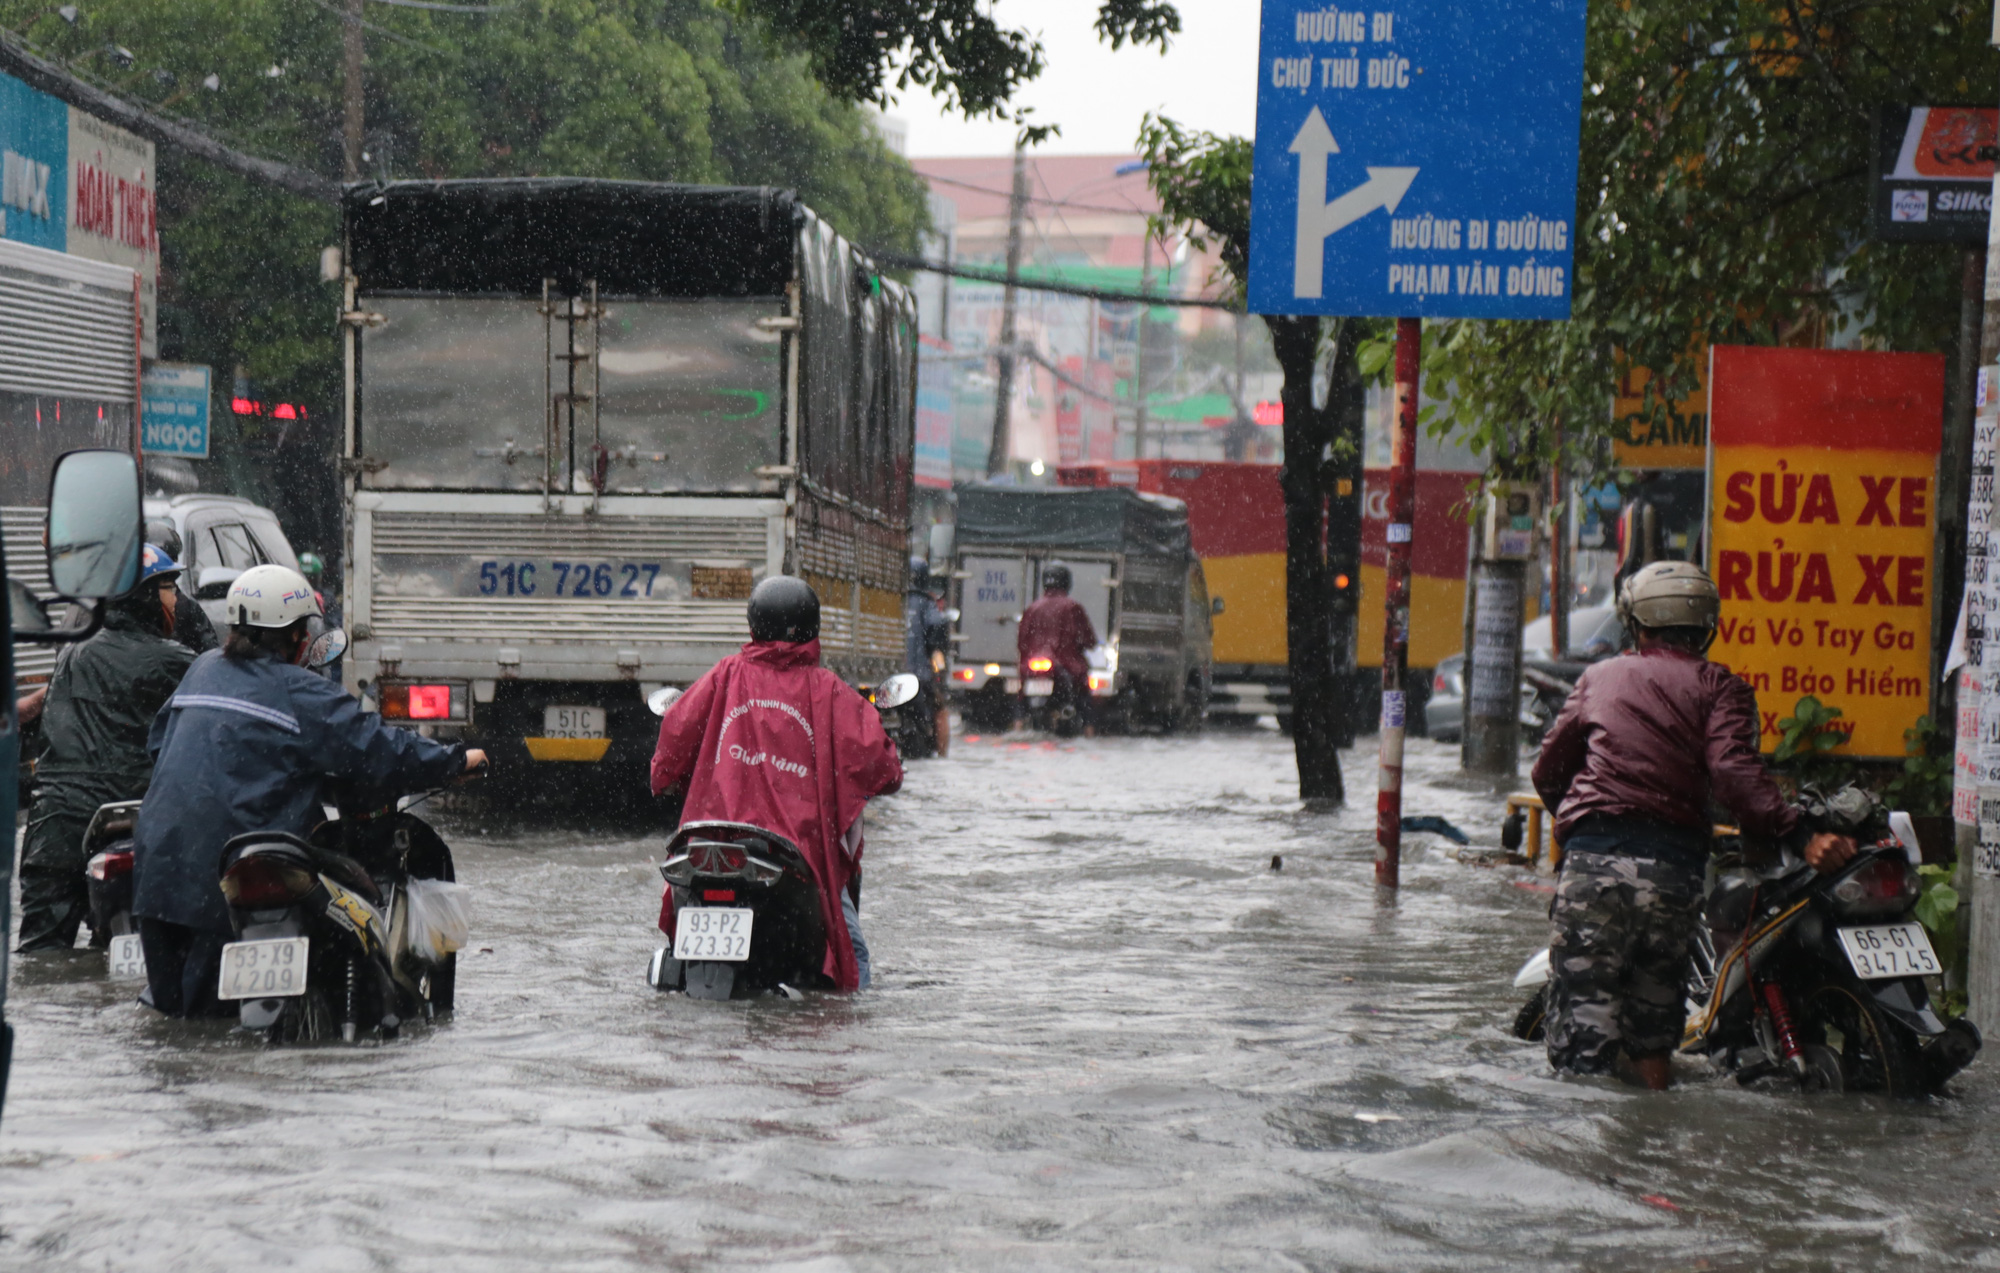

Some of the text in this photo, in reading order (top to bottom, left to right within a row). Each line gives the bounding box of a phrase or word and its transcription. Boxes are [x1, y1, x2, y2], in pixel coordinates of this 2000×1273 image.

[1295, 4, 1393, 43] HƯỚNG ĐI
[1272, 47, 1410, 96] CHỢ THỦ ĐỨC
[1895, 201, 1927, 211] FUCHS
[1390, 212, 1568, 252] HƯỚNG ĐI ĐƯỜNG
[1388, 257, 1565, 302] PHẠM VĂN ĐỒNG
[1723, 459, 1927, 527] SỬA XE
[479, 561, 537, 596] 51C
[1718, 538, 1925, 607] RỬA XE
[233, 587, 262, 598] FILA
[282, 588, 310, 605] FILA
[1718, 617, 1914, 656] Vá Vỏ Tay Ga
[1781, 666, 1835, 694] Bảo
[1846, 666, 1921, 697] Hiểm
[756, 699, 780, 709] TNHH
[560, 710, 591, 729] 51C
[690, 912, 741, 934] 93-P2
[681, 936, 746, 957] 423.32
[1854, 927, 1915, 950] 66-G1
[235, 943, 295, 969] 53-X9
[1857, 950, 1934, 975] 347.45
[232, 968, 293, 993] 4209
